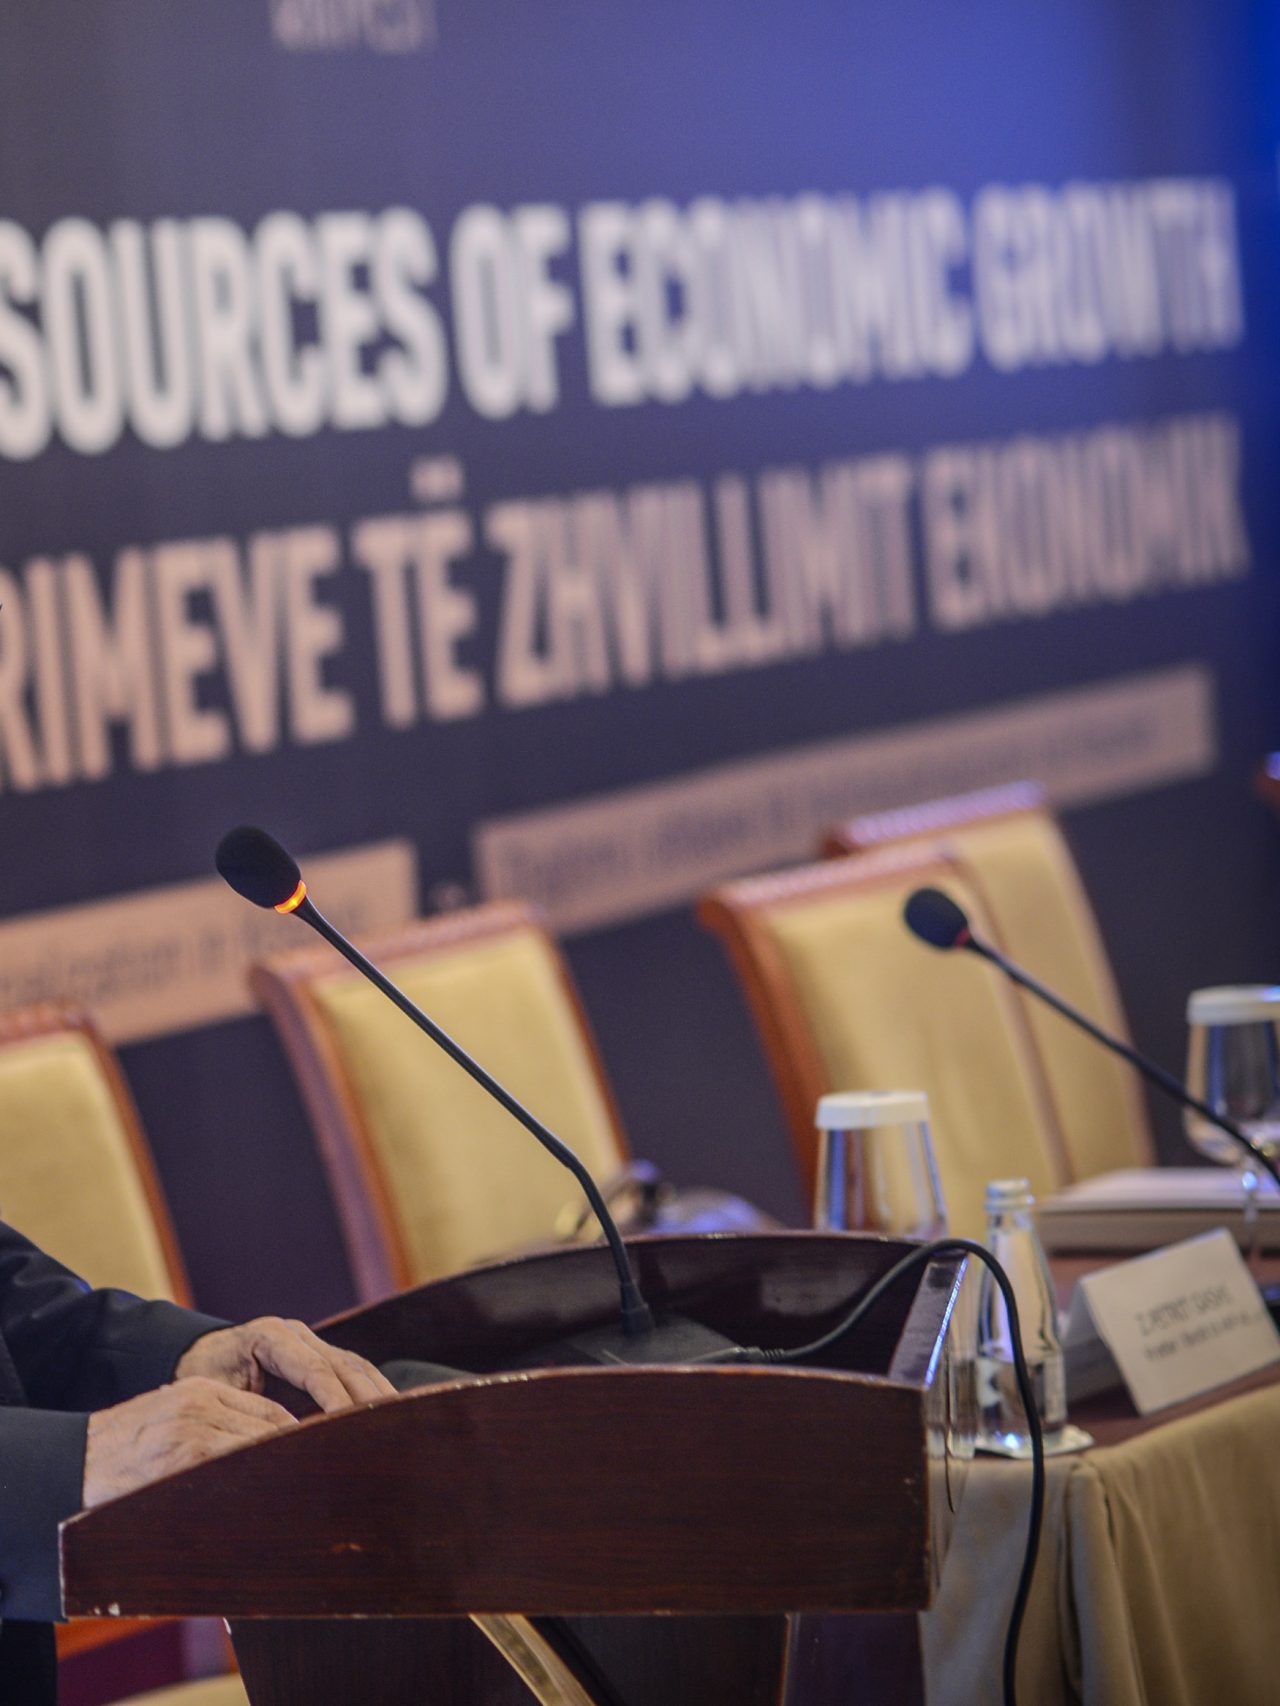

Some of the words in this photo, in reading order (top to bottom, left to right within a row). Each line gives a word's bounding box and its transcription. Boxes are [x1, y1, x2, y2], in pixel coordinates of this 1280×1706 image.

[449, 202, 573, 421] OF
[578, 187, 973, 408] ECONOMIC
[973, 177, 1243, 374] GROWTH
[353, 456, 483, 730] TË
